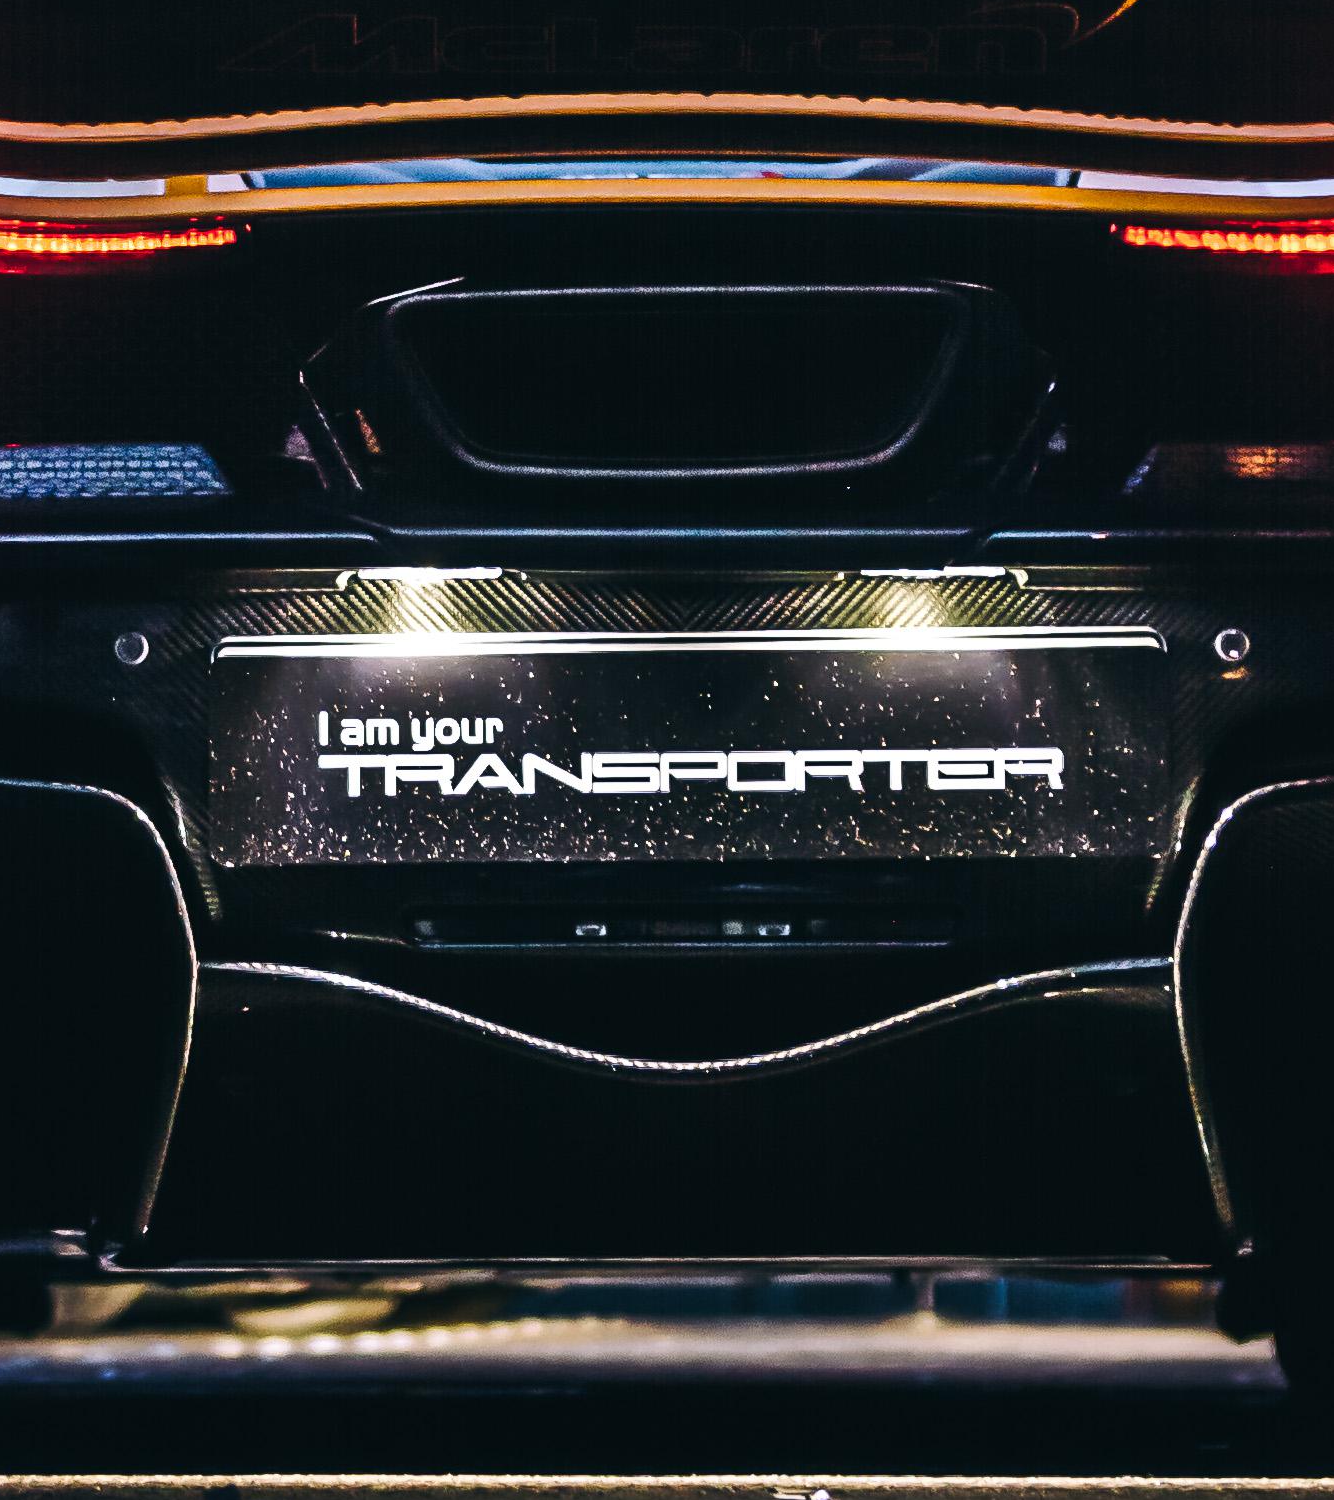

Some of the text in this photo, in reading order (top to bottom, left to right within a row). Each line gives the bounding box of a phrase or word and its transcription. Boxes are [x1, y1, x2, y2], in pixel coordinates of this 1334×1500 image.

[318, 710, 504, 752] I am your
[317, 746, 1065, 797] TRANSPORTER
